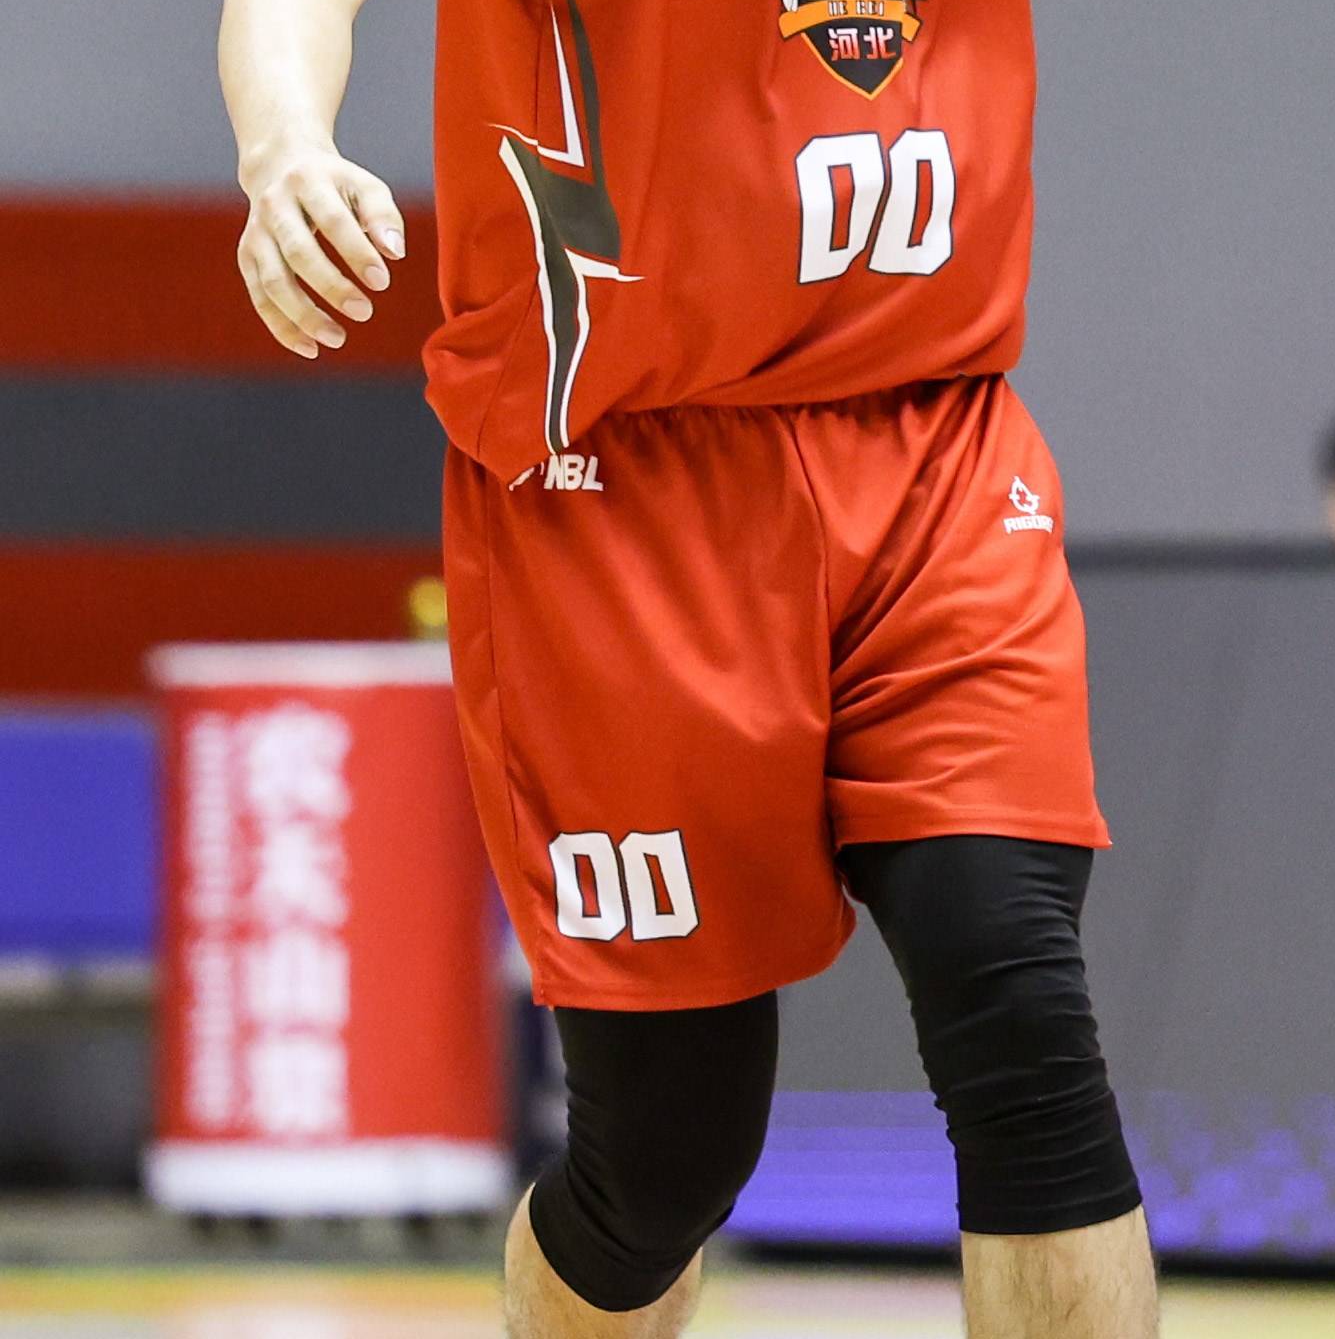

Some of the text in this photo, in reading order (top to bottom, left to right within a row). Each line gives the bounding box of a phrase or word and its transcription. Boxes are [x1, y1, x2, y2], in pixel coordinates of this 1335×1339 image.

[828, 27, 897, 62] 河北
[796, 128, 957, 284] 00
[543, 453, 605, 492] NBL
[549, 830, 700, 942] 00
